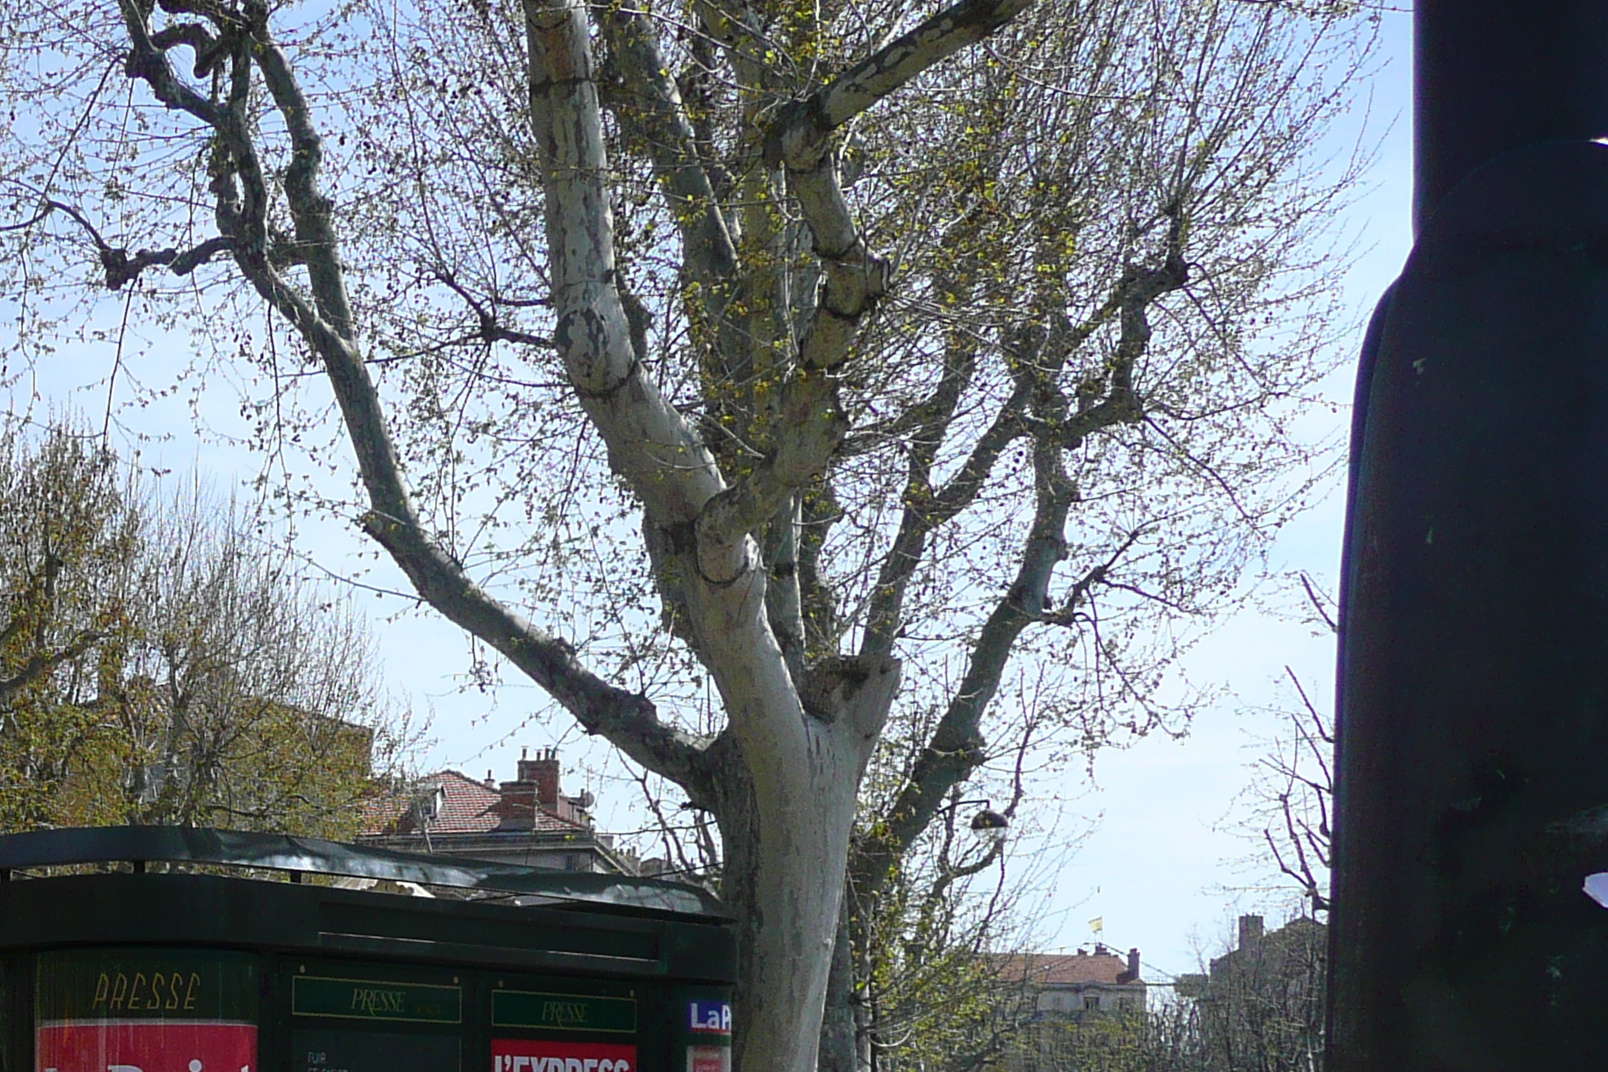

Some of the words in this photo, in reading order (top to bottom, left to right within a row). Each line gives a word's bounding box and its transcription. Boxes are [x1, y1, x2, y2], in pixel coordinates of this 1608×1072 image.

[92, 972, 200, 1010] PRESSE
[350, 988, 406, 1016] PRESSE
[541, 1001, 589, 1027] PRESSE
